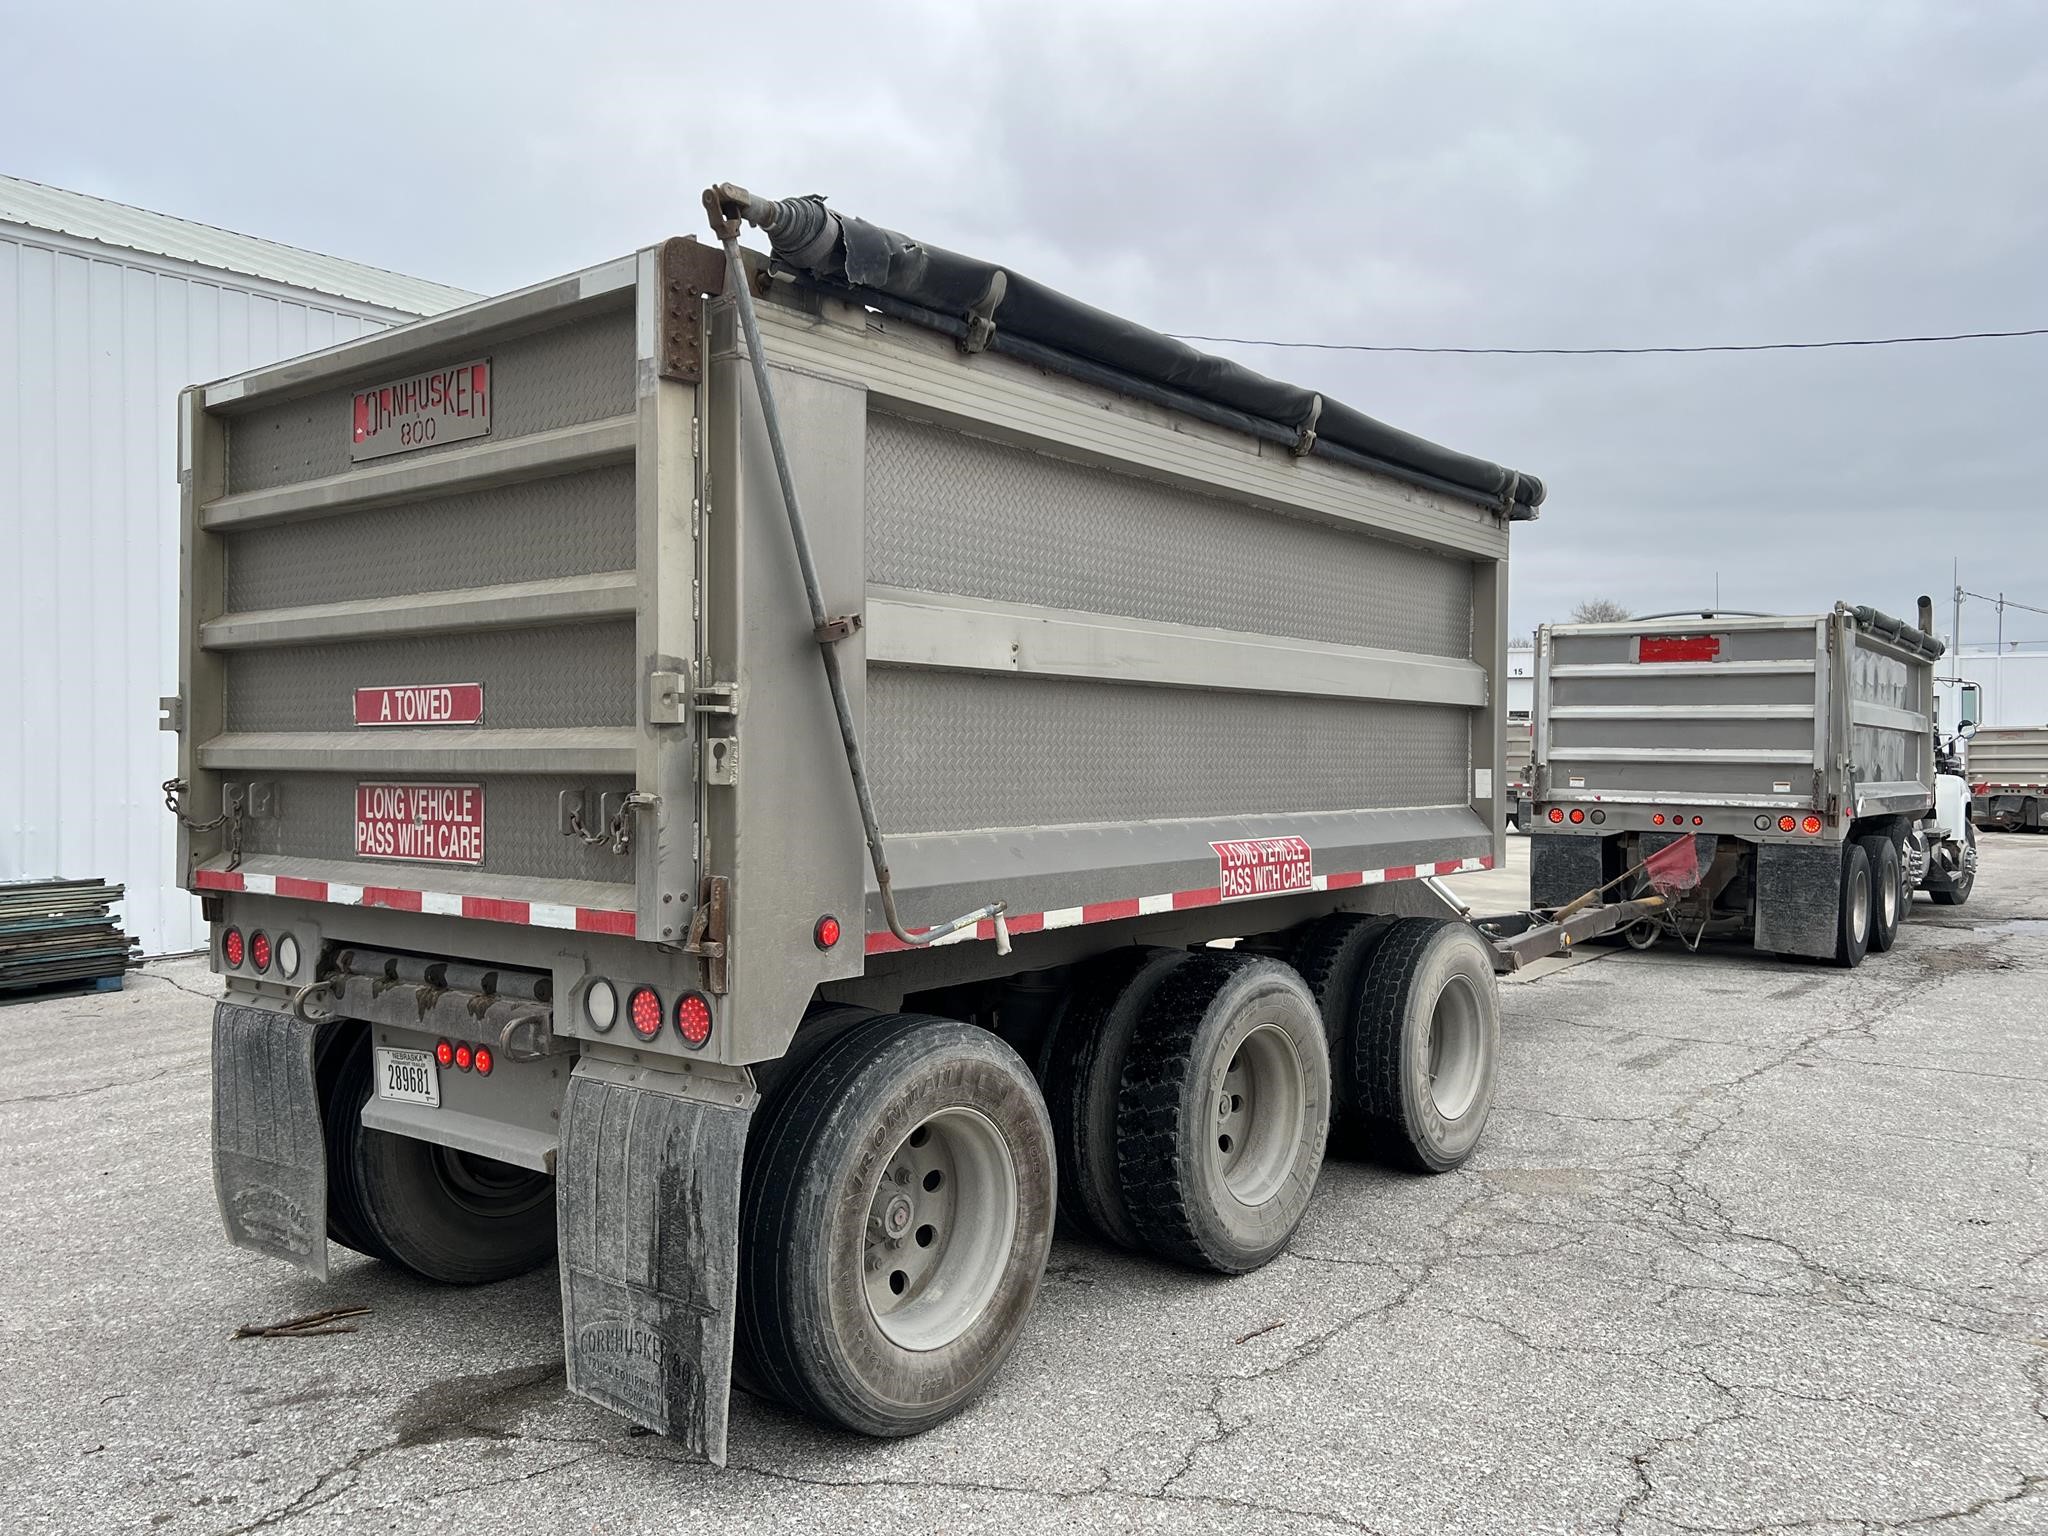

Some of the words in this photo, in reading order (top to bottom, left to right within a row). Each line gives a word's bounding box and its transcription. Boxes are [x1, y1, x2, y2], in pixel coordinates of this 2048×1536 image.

[401, 417, 436, 446] 800
[1514, 667, 1523, 676] 15
[380, 692, 391, 721] A
[395, 688, 452, 721] TOWED
[365, 788, 405, 820] LONG
[408, 789, 472, 823] VEHICLE
[358, 821, 394, 853] PASS
[397, 823, 434, 856] WITH
[438, 824, 481, 859] CARE
[1220, 842, 1259, 867] LONG
[1257, 839, 1305, 863] VEHICLE
[1222, 867, 1252, 896] PASS
[1253, 865, 1280, 891] WITH
[1282, 862, 1311, 889] CARE
[392, 1052, 423, 1062] NEBRASKA
[388, 1064, 431, 1095] 289681
